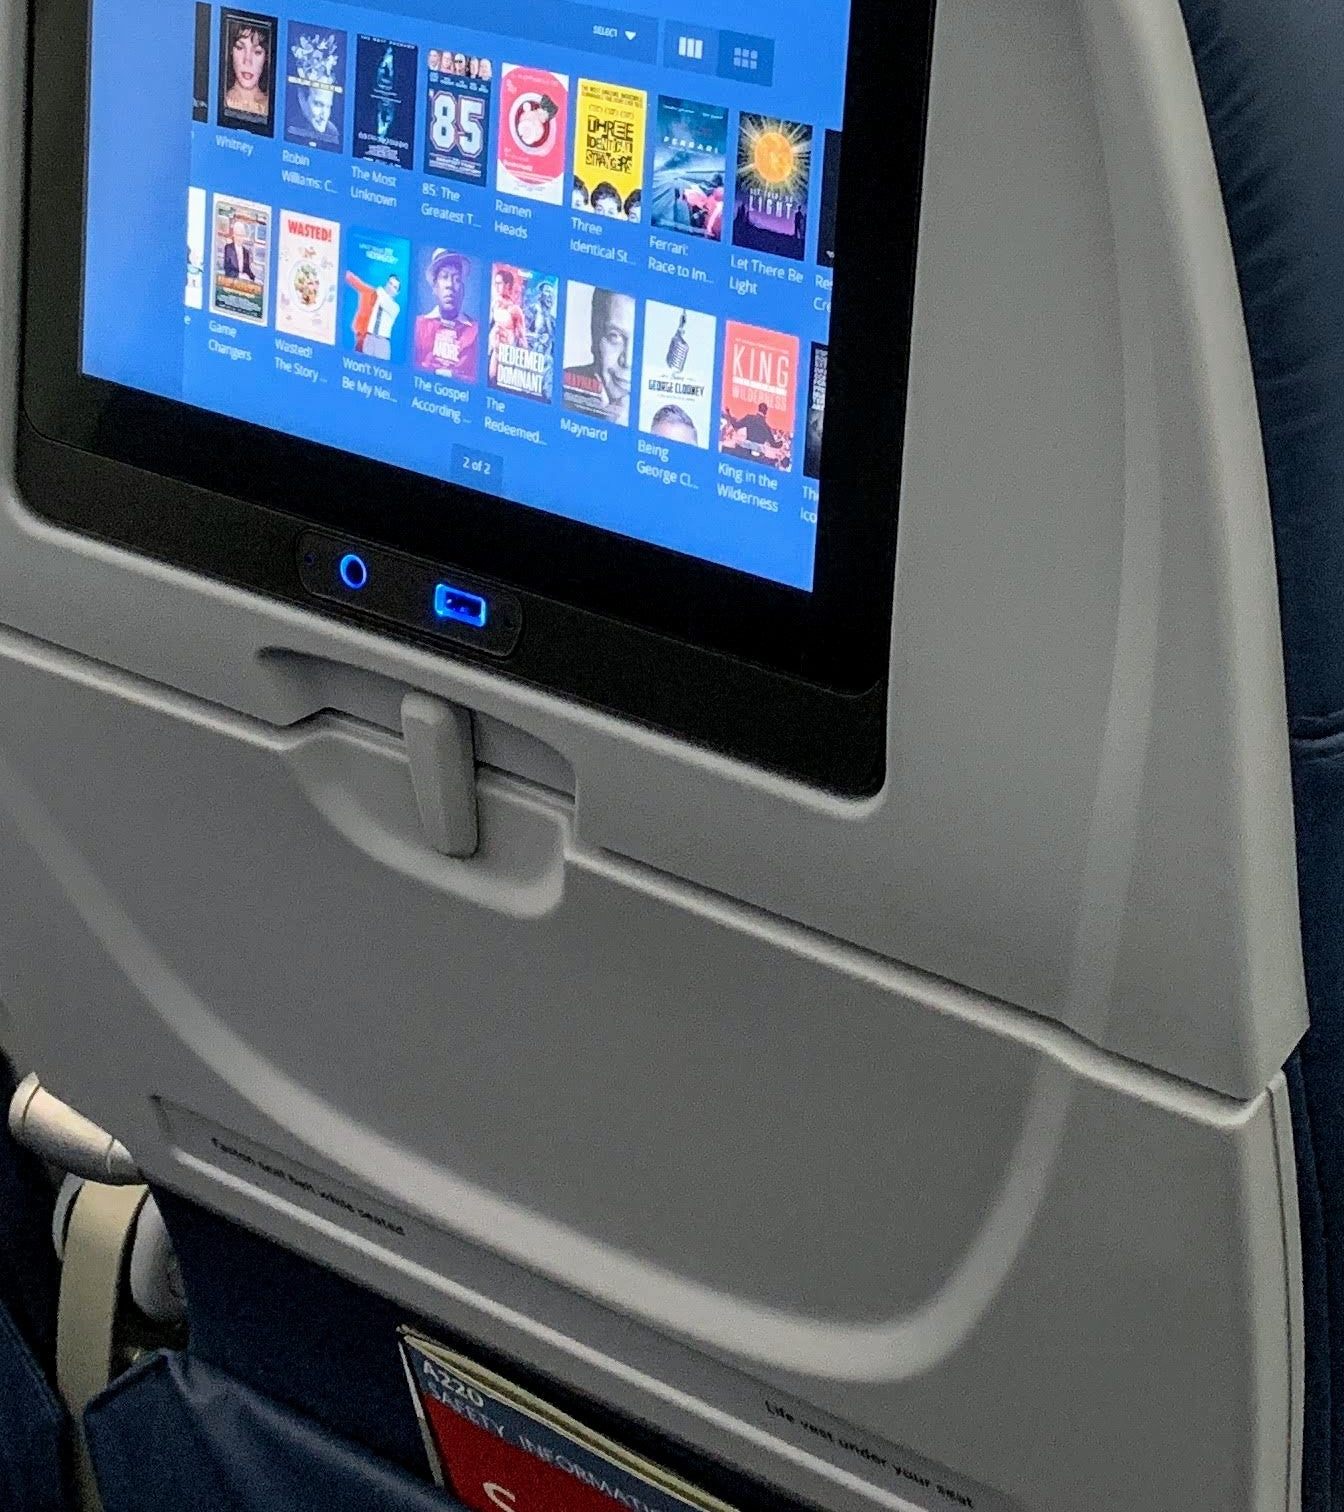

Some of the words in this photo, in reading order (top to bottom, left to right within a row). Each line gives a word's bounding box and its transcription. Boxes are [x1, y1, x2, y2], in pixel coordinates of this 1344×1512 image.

[587, 115, 634, 140] THREE
[215, 135, 254, 157] Whitney
[587, 134, 633, 154] IDENTICAL
[663, 136, 718, 154] FERRARI
[282, 150, 310, 167] Robin
[586, 149, 633, 174] STRANGERS
[352, 166, 369, 181] The
[372, 170, 397, 188] Most
[351, 186, 397, 207] Unknown
[441, 186, 460, 202] The
[421, 203, 463, 224] Greatest
[495, 199, 532, 219] Ramen
[749, 195, 792, 220] LIGHT
[288, 219, 332, 242] WASTED!
[494, 220, 528, 239] Heads
[570, 217, 602, 236] Three
[570, 239, 614, 260] Identical
[648, 257, 676, 276] Race
[677, 261, 689, 277] to
[730, 254, 749, 271] Let
[751, 256, 785, 279] There
[788, 268, 804, 284] Be
[729, 276, 758, 296] Light
[209, 320, 237, 339] Game
[208, 339, 252, 361] Changers
[275, 337, 313, 358] Wasted!
[498, 343, 545, 373] REDEEMED
[275, 357, 292, 373] The
[294, 363, 319, 383] Story
[342, 357, 371, 375] Won't
[373, 365, 392, 381] You
[732, 343, 790, 388] KING
[342, 377, 355, 390] Be
[357, 380, 372, 399] My
[413, 376, 432, 393] The
[434, 381, 470, 403] Gospel
[497, 364, 544, 394] DOMINANT
[648, 379, 673, 394] GEORGE
[674, 382, 705, 397] CLOONEY
[411, 397, 462, 424] According
[486, 397, 505, 413] The
[732, 388, 787, 412] WILDERNESS
[560, 418, 608, 441] Maynard
[638, 439, 669, 463] Being
[463, 457, 470, 468] 2
[472, 458, 483, 471] of
[483, 462, 491, 475] 2
[636, 461, 677, 484] George
[717, 462, 743, 484] King
[745, 468, 755, 483] in
[758, 473, 778, 491] the
[717, 483, 779, 513] Wilderness
[423, 1360, 485, 1408] A220
[427, 1380, 505, 1437] SAFETY
[765, 1399, 795, 1424] Life
[800, 1419, 834, 1443] vest
[838, 1438, 887, 1467] under
[892, 1463, 931, 1488] your
[936, 1484, 974, 1510] seat
